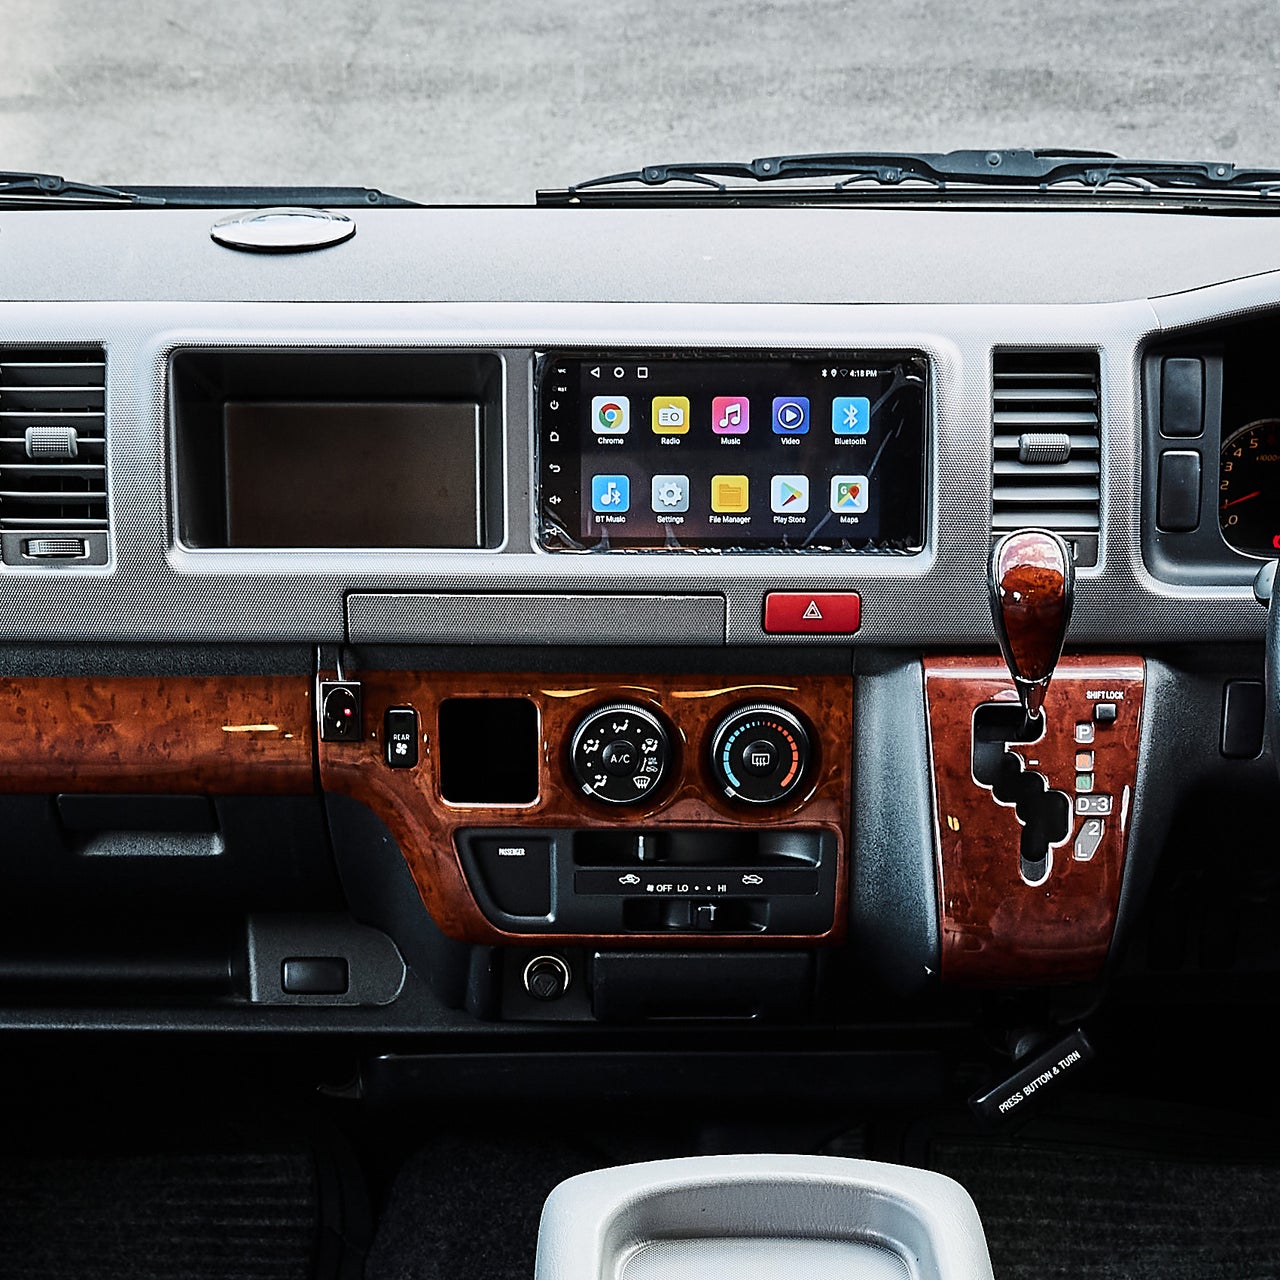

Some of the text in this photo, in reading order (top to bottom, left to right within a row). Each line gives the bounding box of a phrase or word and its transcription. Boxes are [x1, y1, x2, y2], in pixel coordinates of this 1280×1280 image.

[865, 369, 878, 377] PM
[597, 436, 624, 445] Chrome
[661, 436, 681, 445] Radio
[720, 436, 741, 445] Music
[780, 436, 801, 445] Video
[834, 436, 867, 445] Bluetooth
[1249, 438, 1259, 449] 5
[1233, 448, 1243, 457] 4
[1224, 461, 1233, 472] 3
[1220, 480, 1229, 490] 2
[657, 516, 684, 525] Settings
[722, 516, 751, 525] Manager
[773, 516, 788, 525] Play
[840, 516, 859, 525] Maps
[1228, 514, 1238, 525] 0
[1086, 690, 1124, 700] SHIFT LOCK
[393, 733, 410, 741] REAR
[1078, 727, 1090, 739] P
[610, 753, 631, 764] A/C
[1078, 776, 1091, 788] N
[1077, 797, 1109, 811] D-3
[1089, 822, 1099, 836] 2
[1077, 844, 1088, 857] L
[656, 884, 727, 892] OFF LO HI
[998, 1050, 1081, 1114] PRESS BUTTON & TURN
